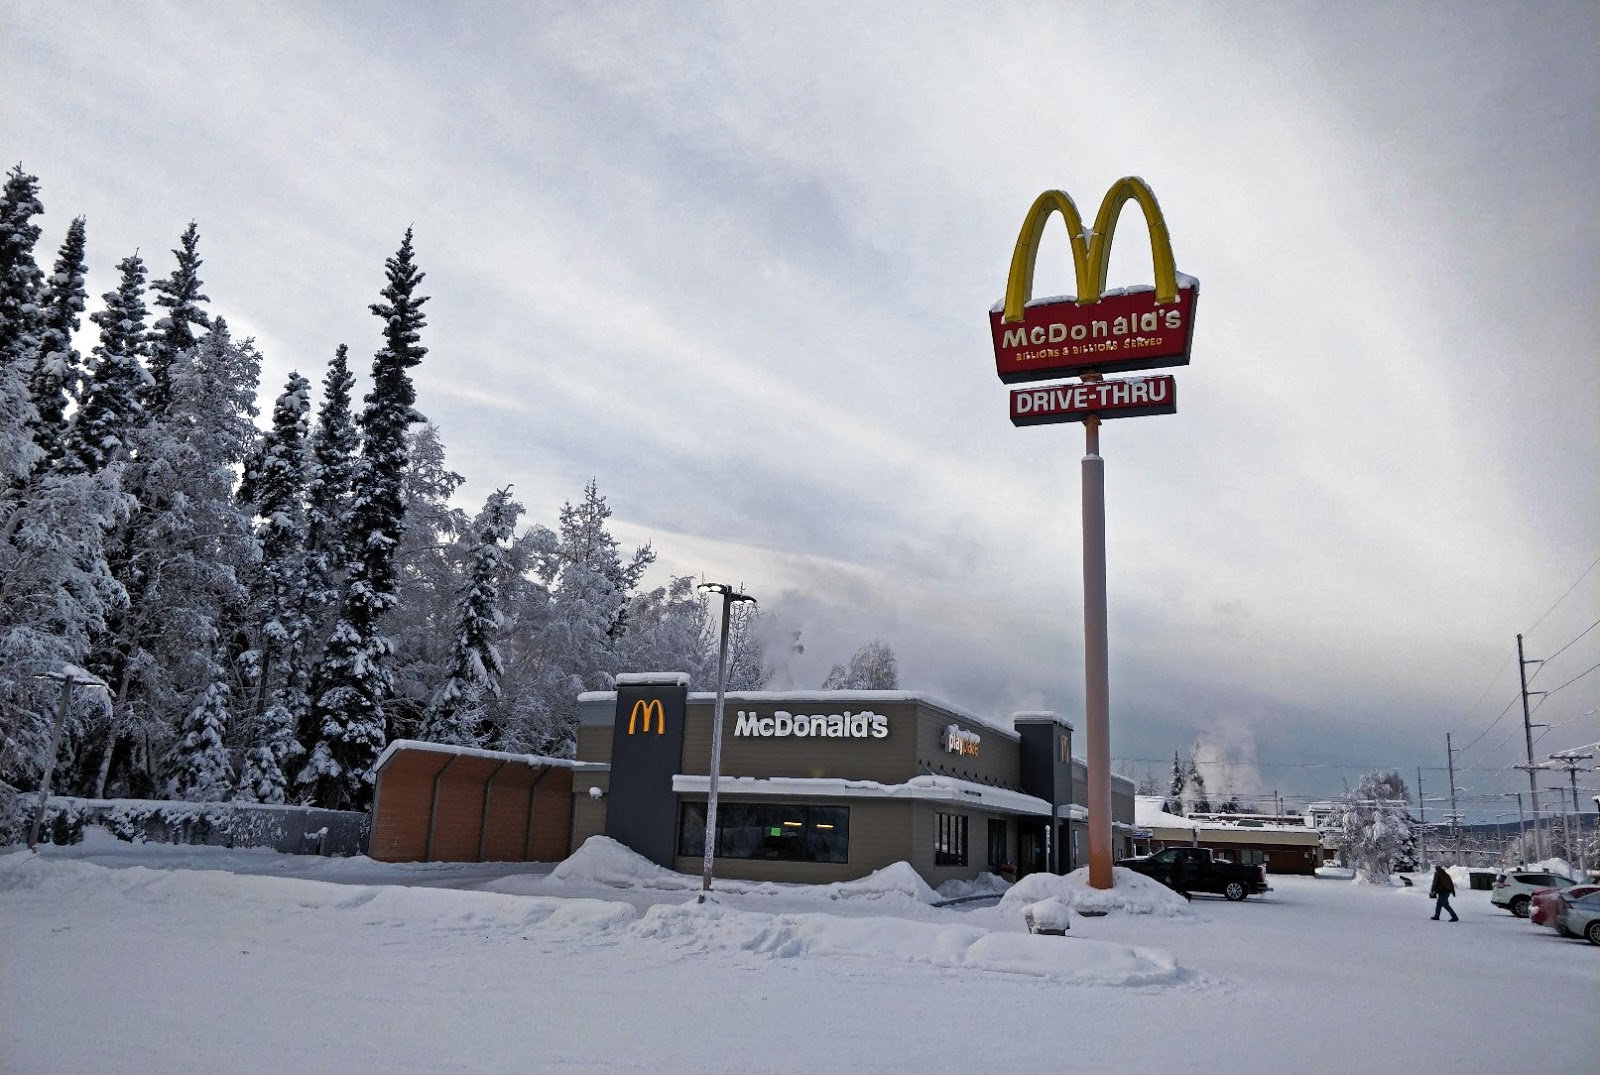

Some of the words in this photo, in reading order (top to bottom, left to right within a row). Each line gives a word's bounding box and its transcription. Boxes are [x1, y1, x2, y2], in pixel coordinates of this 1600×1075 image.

[1002, 309, 1182, 348] McDonald's
[1016, 348, 1059, 361] BILLIONS
[1072, 340, 1118, 355] BILLIONS
[1123, 337, 1163, 349] SERVED
[1016, 380, 1166, 413] DRIVE-THRU
[733, 711, 889, 738] McDonald's
